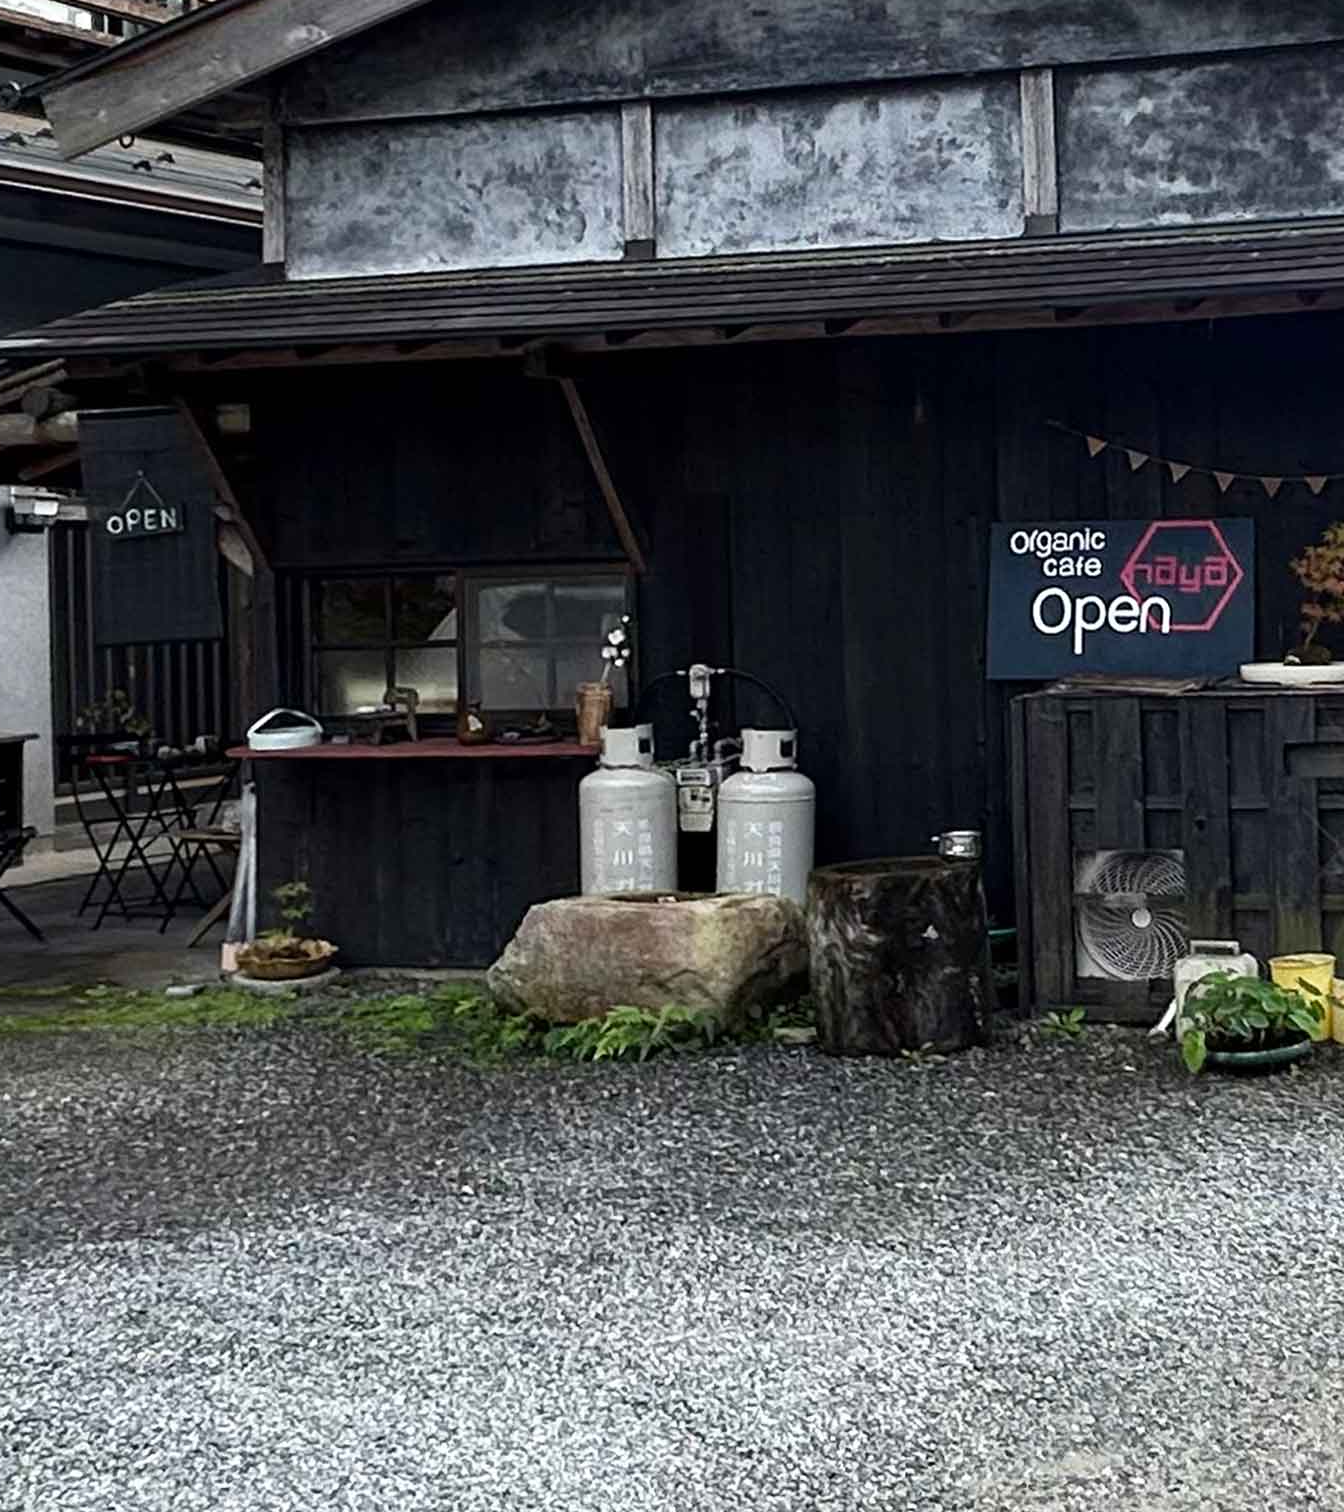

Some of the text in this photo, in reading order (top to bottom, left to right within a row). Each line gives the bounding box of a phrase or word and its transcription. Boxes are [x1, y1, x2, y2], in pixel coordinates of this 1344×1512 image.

[106, 508, 176, 534] OPEN
[1010, 528, 1105, 557] organic
[1043, 557, 1102, 576] cafe
[1130, 556, 1229, 593] naya
[1033, 587, 1171, 654] Open
